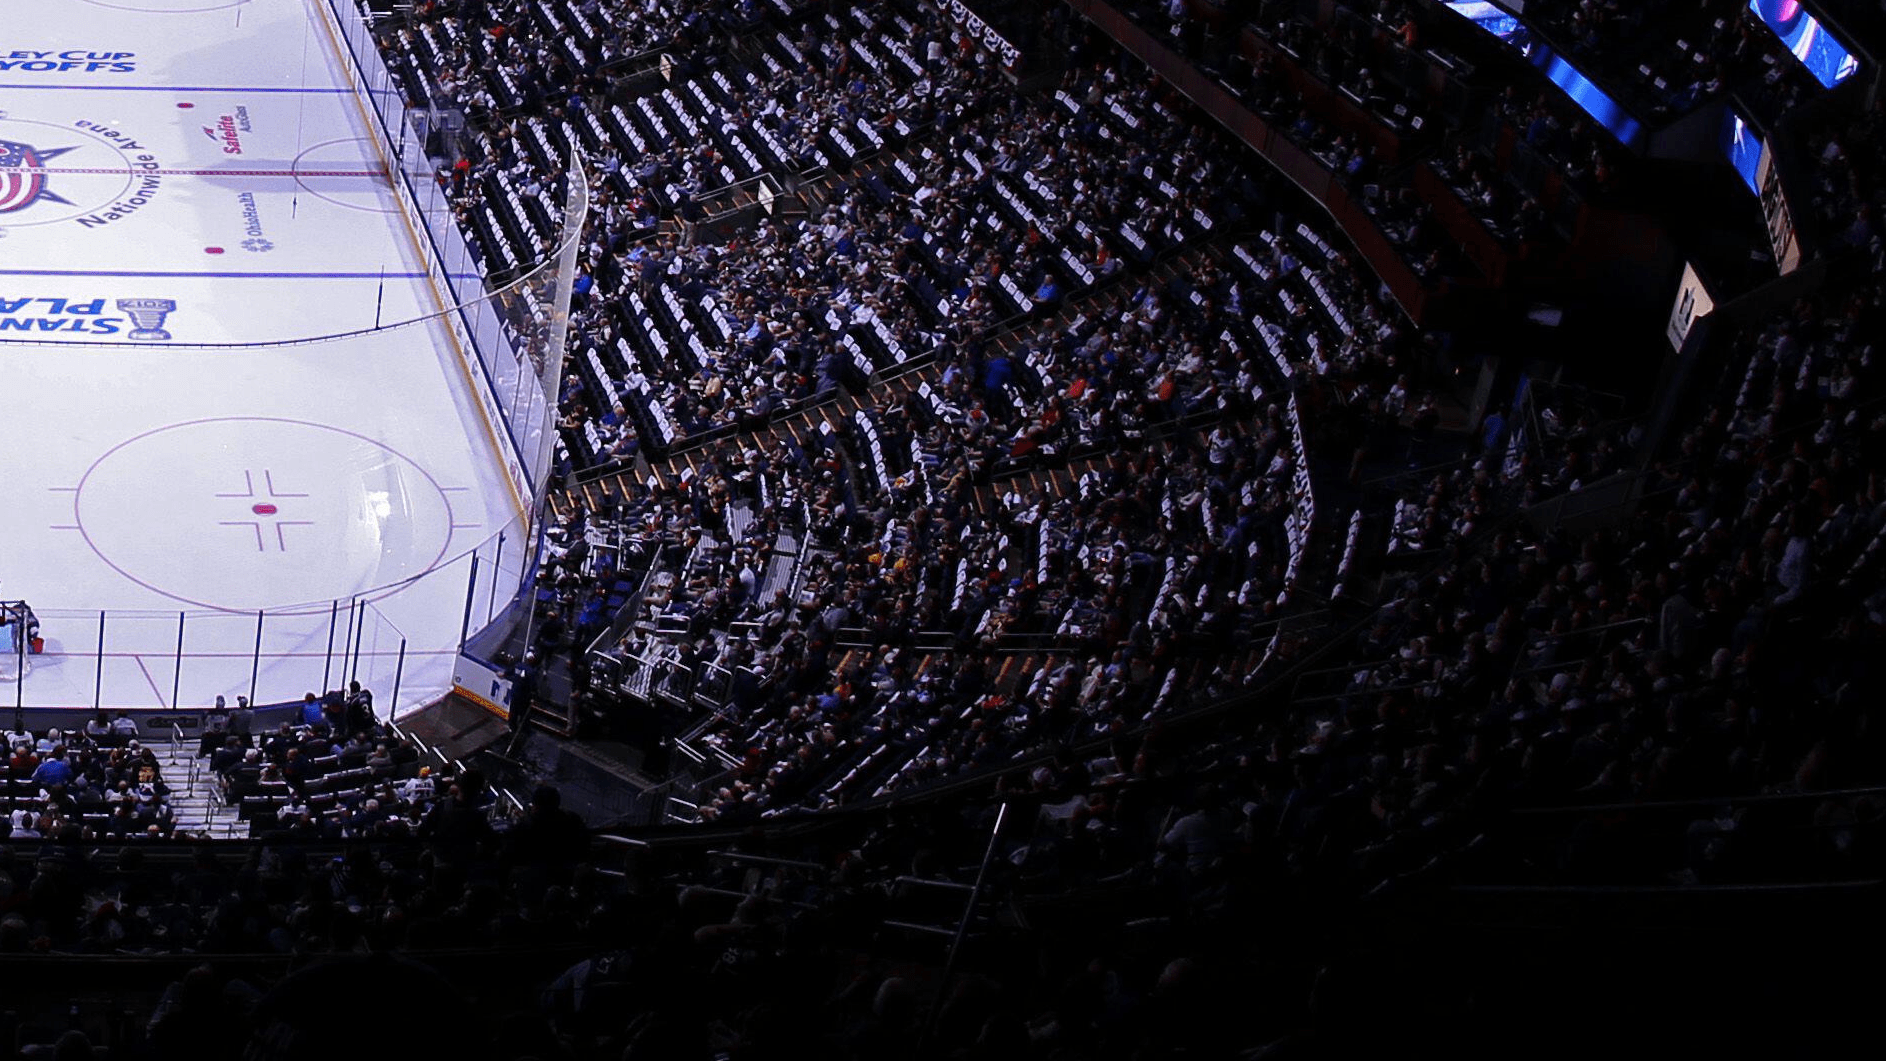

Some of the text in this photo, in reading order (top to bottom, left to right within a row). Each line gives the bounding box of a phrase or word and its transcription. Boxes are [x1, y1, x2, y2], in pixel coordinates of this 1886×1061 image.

[58, 50, 136, 61] CUP
[216, 115, 243, 155] Safelite
[74, 120, 162, 229] Nationwide Arena
[237, 192, 263, 237] OhioHealth
